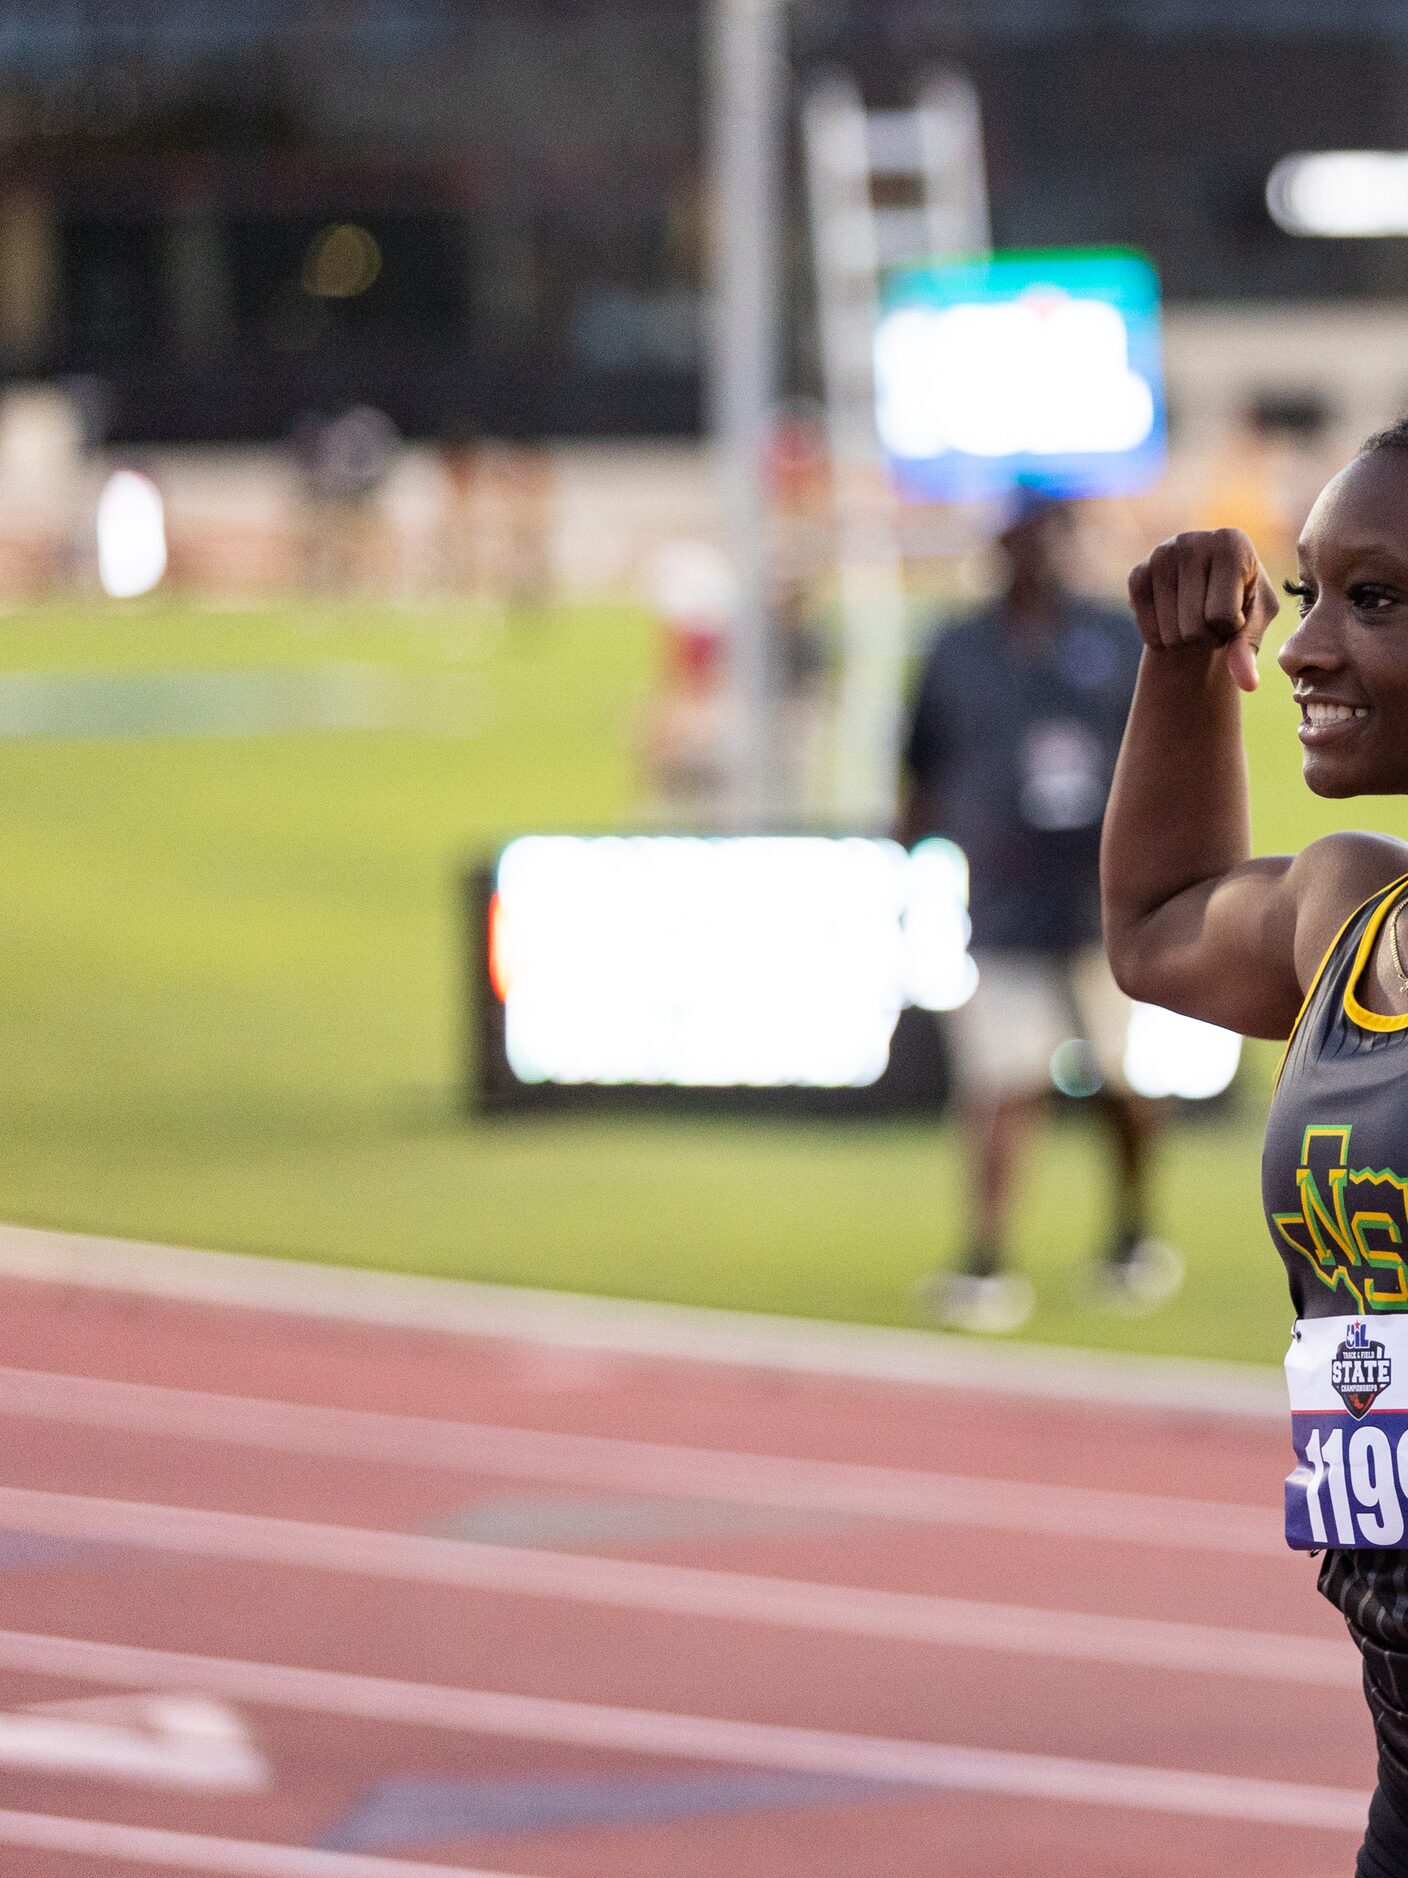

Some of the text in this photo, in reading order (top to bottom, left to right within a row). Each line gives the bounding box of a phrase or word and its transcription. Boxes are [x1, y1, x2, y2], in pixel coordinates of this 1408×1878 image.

[1361, 1351, 1375, 1359] FIELD
[1332, 1360, 1390, 1383] STATE
[1341, 1384, 1377, 1392] CHAMPIONSHIPS
